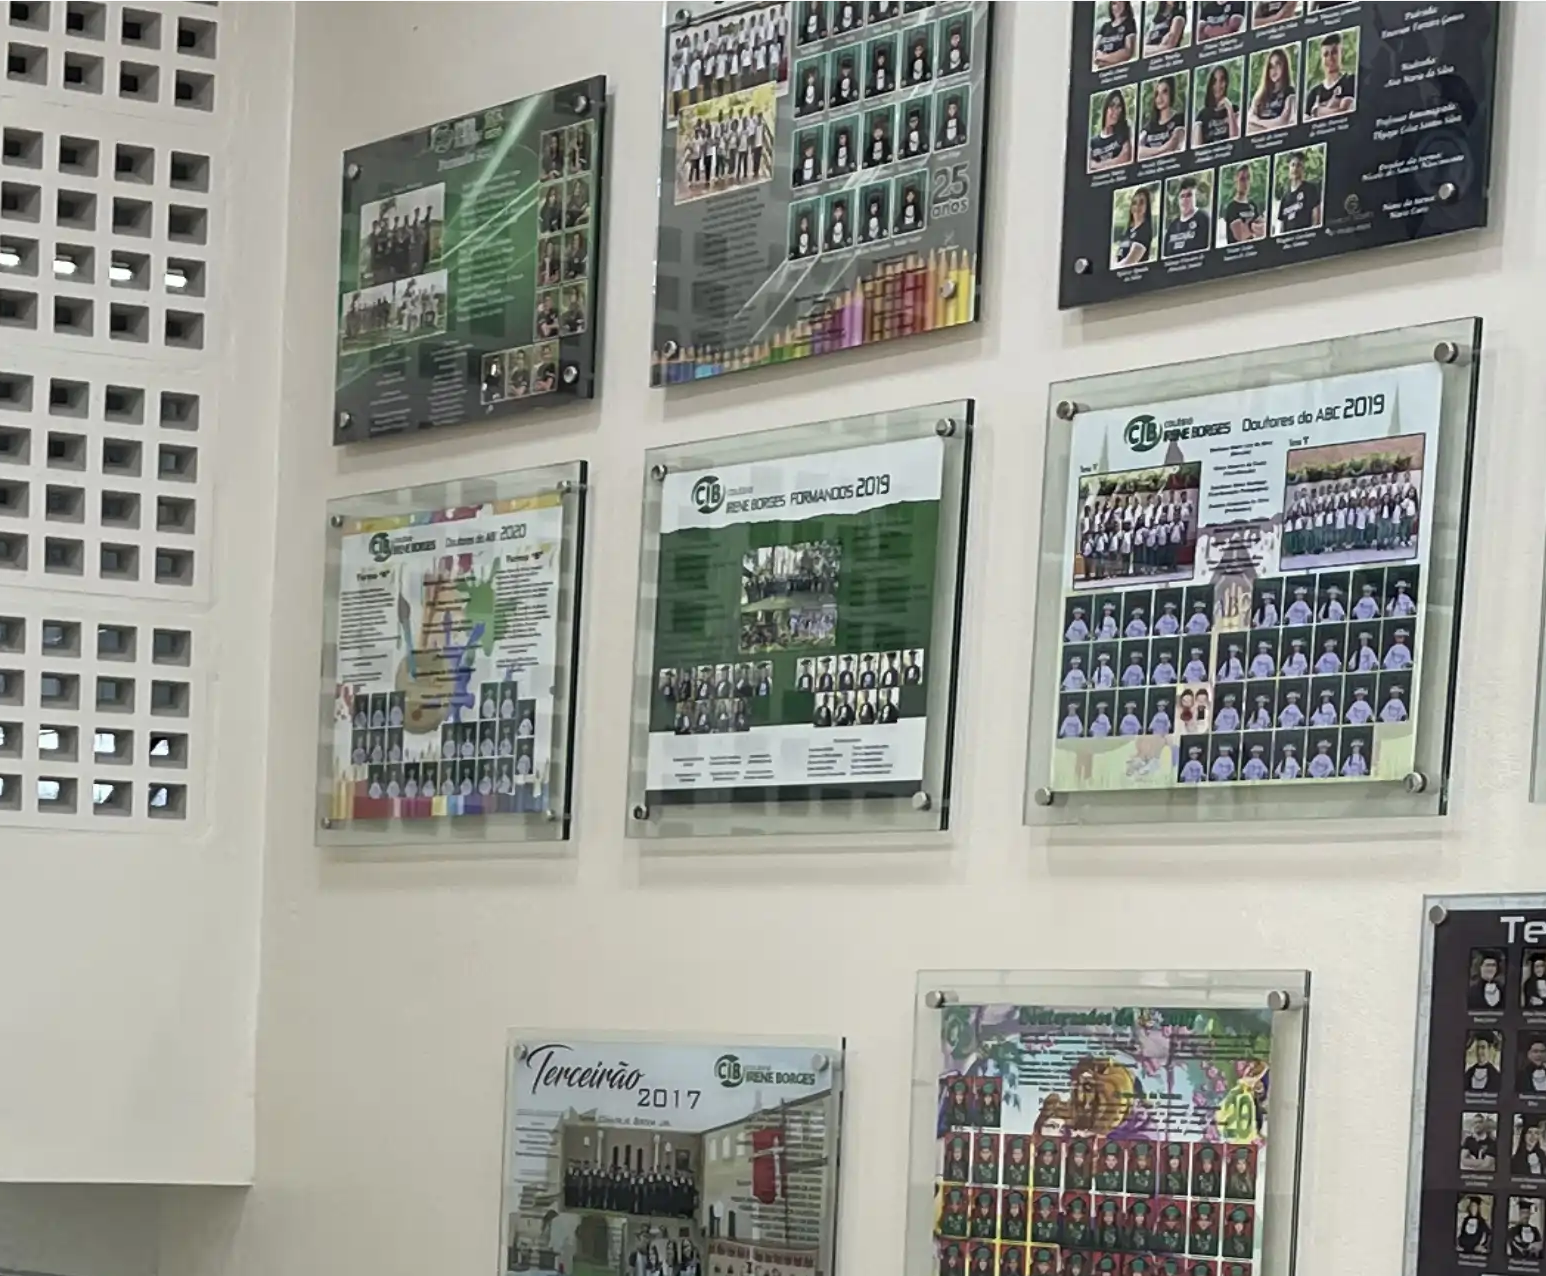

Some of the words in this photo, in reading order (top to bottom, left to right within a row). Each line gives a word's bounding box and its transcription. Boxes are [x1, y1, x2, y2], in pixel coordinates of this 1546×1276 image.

[933, 164, 969, 200] 25
[931, 196, 969, 219] anos
[1242, 415, 1295, 432] Doutores
[1297, 412, 1313, 428] do
[1316, 405, 1340, 422] ABC
[1343, 394, 1385, 418] 2019
[1128, 424, 1156, 448] CIB
[1191, 422, 1231, 439] BORGES
[695, 484, 720, 506] CIB
[790, 485, 854, 506] FORMANDOS
[856, 474, 890, 498] 2019
[751, 495, 785, 512] BORGES
[500, 524, 526, 540] 2020
[526, 1044, 645, 1094] Terceirão
[718, 1062, 741, 1081] CIB
[746, 1070, 774, 1084] IRENE
[776, 1072, 815, 1085] BORGES
[637, 1088, 701, 1109] 2017
